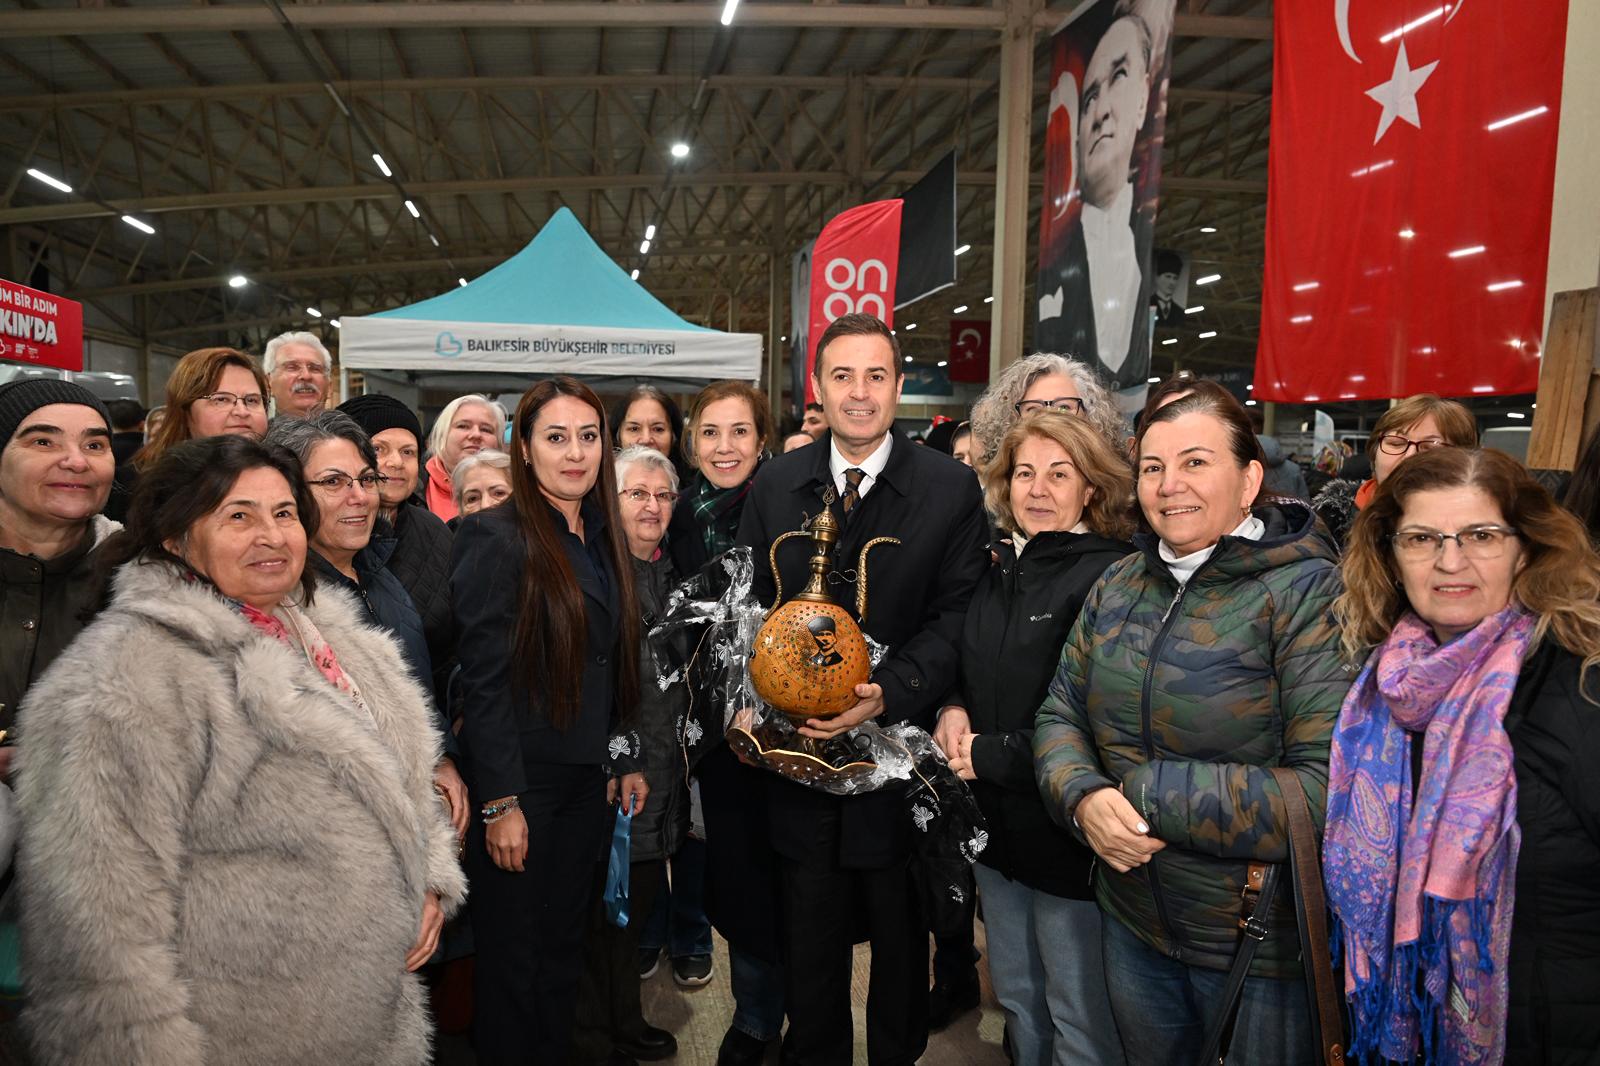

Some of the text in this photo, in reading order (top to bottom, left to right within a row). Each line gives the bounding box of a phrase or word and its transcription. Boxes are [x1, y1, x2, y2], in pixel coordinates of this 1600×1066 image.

[14, 289, 31, 309] BİR
[33, 297, 57, 316] ADIM
[467, 337, 675, 356] BALIKESİR BÜYÜKŞEHİR BELEDİYESİ
